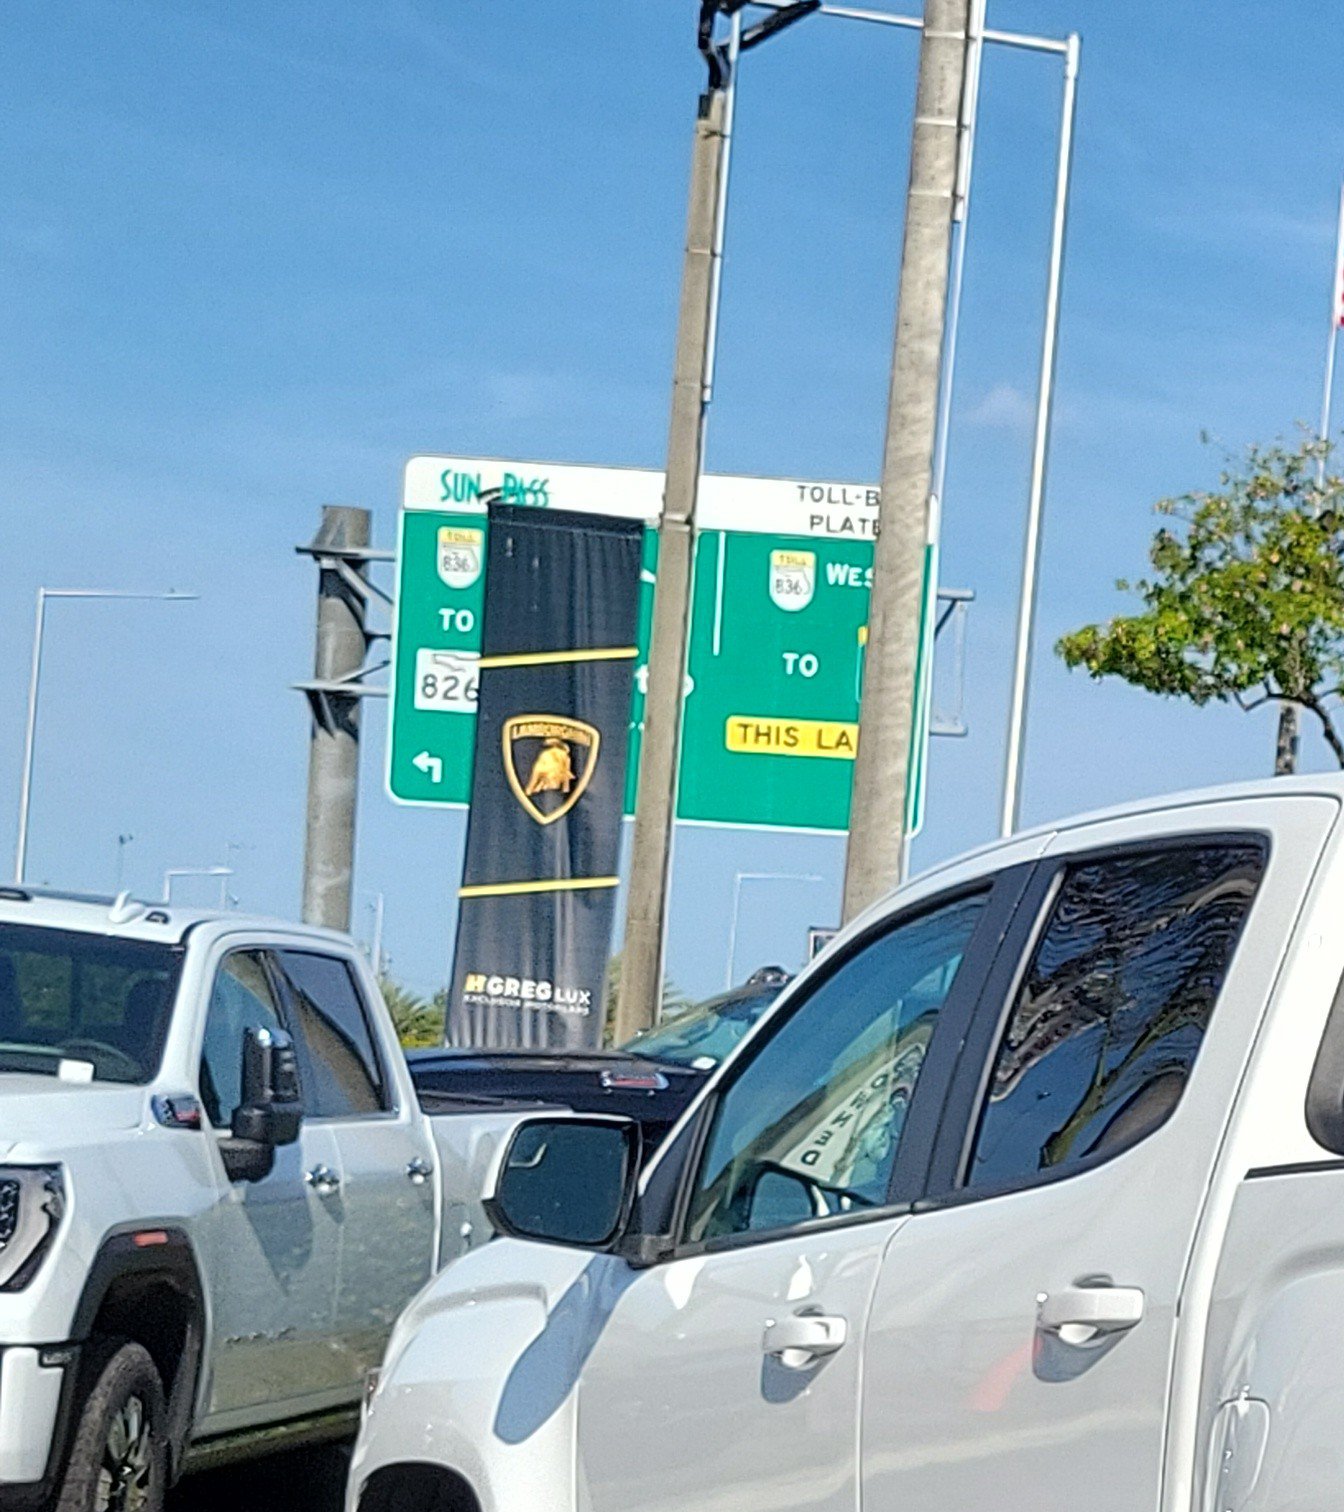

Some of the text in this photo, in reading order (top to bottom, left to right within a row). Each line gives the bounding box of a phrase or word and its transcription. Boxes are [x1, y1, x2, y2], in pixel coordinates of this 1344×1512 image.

[438, 608, 475, 632] TO
[782, 652, 819, 678] TO
[421, 673, 479, 702] 826
[736, 723, 800, 747] THIS
